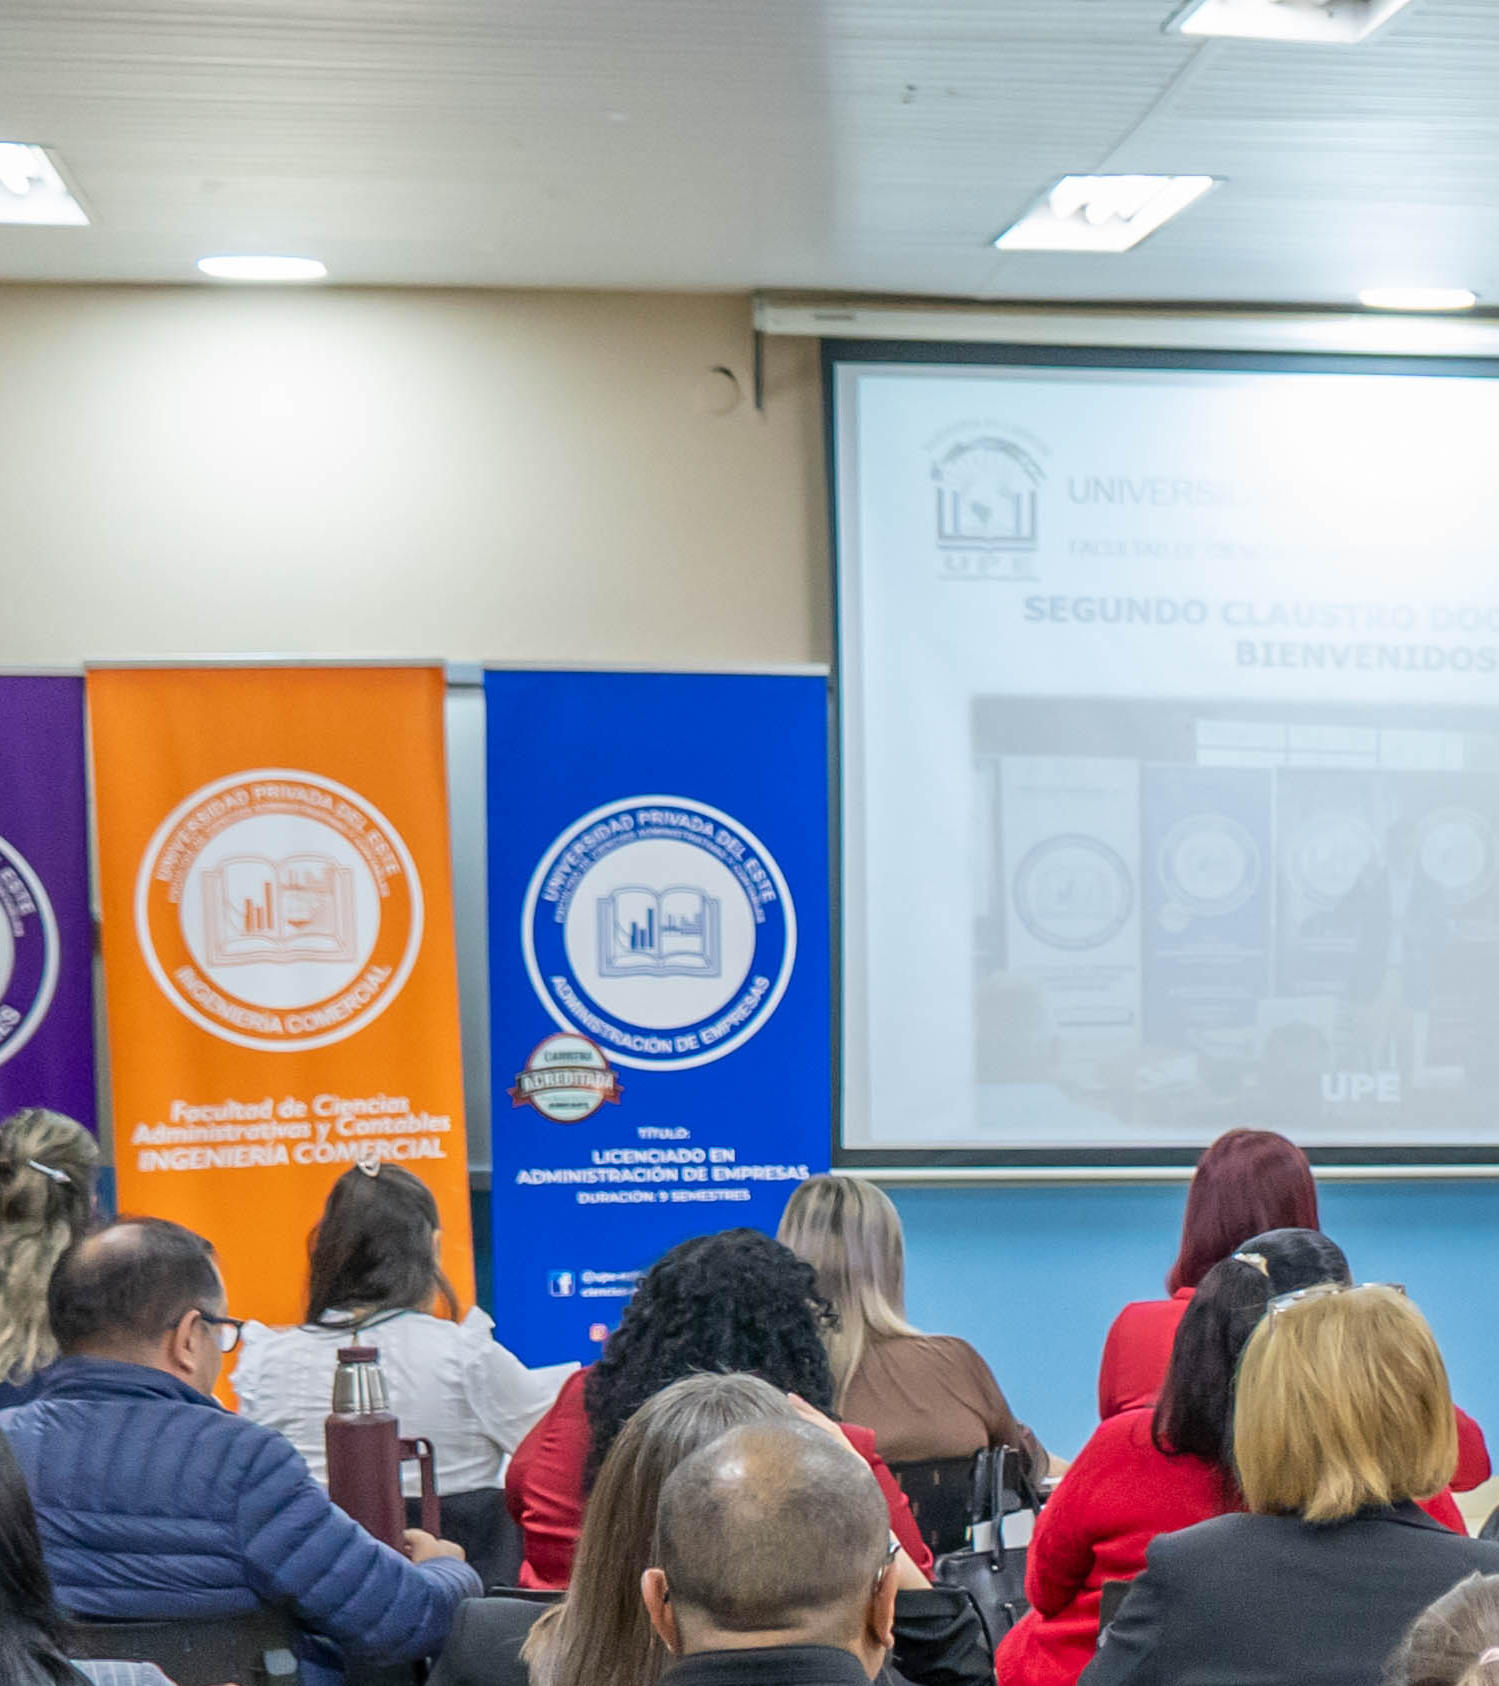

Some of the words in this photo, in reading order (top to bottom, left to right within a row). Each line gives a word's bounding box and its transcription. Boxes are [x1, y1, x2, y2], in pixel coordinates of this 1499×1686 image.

[1022, 594, 1208, 626] SEGUNDO
[1221, 599, 1414, 632] CLAUSTRO
[1235, 639, 1499, 673] BIENVENIDOS
[253, 784, 333, 809] PRIVADA
[336, 801, 367, 831] DEL
[367, 829, 401, 876] ESTE
[541, 813, 635, 902] UNIVERSIDAD
[637, 809, 714, 837] PRIVADA
[715, 829, 746, 862] DEL
[743, 857, 776, 904] ESTE
[285, 964, 392, 1033] COMERCIAL
[675, 1034, 700, 1052] DE
[701, 976, 771, 1043] EMPRESAS
[1321, 1074, 1402, 1103] UPE
[170, 1098, 273, 1123] Facultad
[277, 1095, 307, 1119] de
[313, 1092, 410, 1117] Ciencias
[132, 1117, 311, 1145] Administrativas
[316, 1120, 332, 1144] y
[335, 1112, 451, 1138] Contables
[293, 1136, 446, 1166] COMERCIAL
[592, 1149, 705, 1166] LICENCIADO
[709, 1147, 736, 1164] EN
[516, 1165, 678, 1185] ADMINISTRACIÓN
[682, 1166, 708, 1182] DE
[712, 1164, 810, 1182] EMPRESAS
[671, 1188, 751, 1203] SEMESTRES
